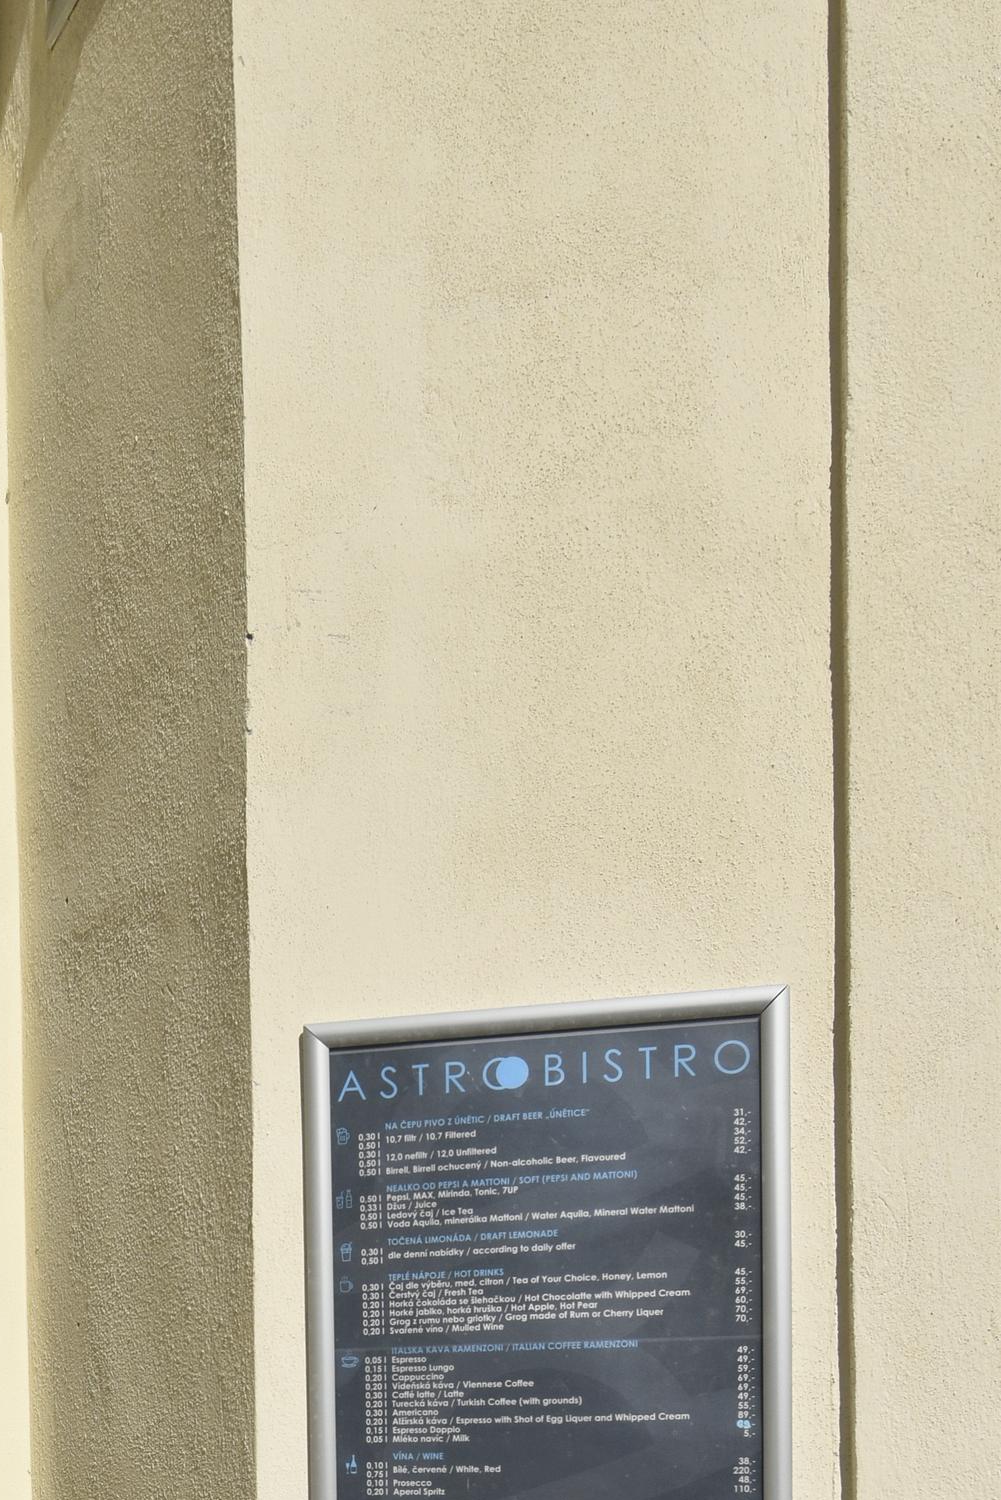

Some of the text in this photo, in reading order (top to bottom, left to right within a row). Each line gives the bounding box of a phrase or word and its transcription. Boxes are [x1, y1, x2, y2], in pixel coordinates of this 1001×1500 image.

[337, 1039, 752, 1103] ASTRO BISTRO
[399, 1118, 421, 1128] ČEPU
[424, 1118, 445, 1126] PIVO
[493, 1113, 519, 1122] DRAFT
[522, 1112, 542, 1120] BEER
[456, 1146, 496, 1156] Unfiltered
[412, 1164, 435, 1172] Birrell
[437, 1161, 481, 1172] ochucený
[490, 1156, 552, 1167] Non-alcoholic
[580, 1152, 625, 1161] Flavoured
[386, 1182, 420, 1191] NEALKO
[438, 1180, 459, 1188] PEPSI
[470, 1177, 509, 1186] MATTONI
[519, 1175, 538, 1183] SOFT
[541, 1173, 567, 1183] (PEPSI
[570, 1172, 590, 1180] AND
[592, 1169, 637, 1180] MATTONI)
[386, 1192, 409, 1202] Pepsi,
[414, 1200, 436, 1208] Juice
[387, 1210, 417, 1220] Ledový
[419, 1209, 433, 1218] čaj
[444, 1215, 487, 1224] minerálka
[489, 1213, 522, 1222] Mattoni
[531, 1211, 557, 1219] Water
[593, 1207, 628, 1216] Mineral
[630, 1206, 656, 1214] Water
[658, 1204, 694, 1212] Mattoni
[388, 1229, 557, 1244] TOČENÁ LIMONÁDA DRAFT LEMONADE
[429, 1247, 464, 1258] nabídky
[472, 1245, 518, 1256] according
[530, 1243, 553, 1253] daily
[411, 1268, 445, 1278] NÁPOJE
[473, 1268, 504, 1276] DRINKS
[388, 1287, 419, 1299] Čerstvý
[422, 1289, 435, 1298] čaj
[416, 1296, 456, 1305] čokoláda
[470, 1294, 515, 1303] šlehačkou
[541, 1291, 591, 1300] Chocolatte
[614, 1289, 656, 1300] Whipped
[658, 1288, 690, 1296] Cream
[547, 1341, 581, 1349] COFFEE
[391, 1363, 454, 1373] Espresso Lungo
[391, 1372, 444, 1382] Cappuccino
[392, 1425, 460, 1435] Espresso Doppio
[392, 1450, 413, 1459] VÍNA
[393, 1487, 444, 1496] Aperol Spritz
